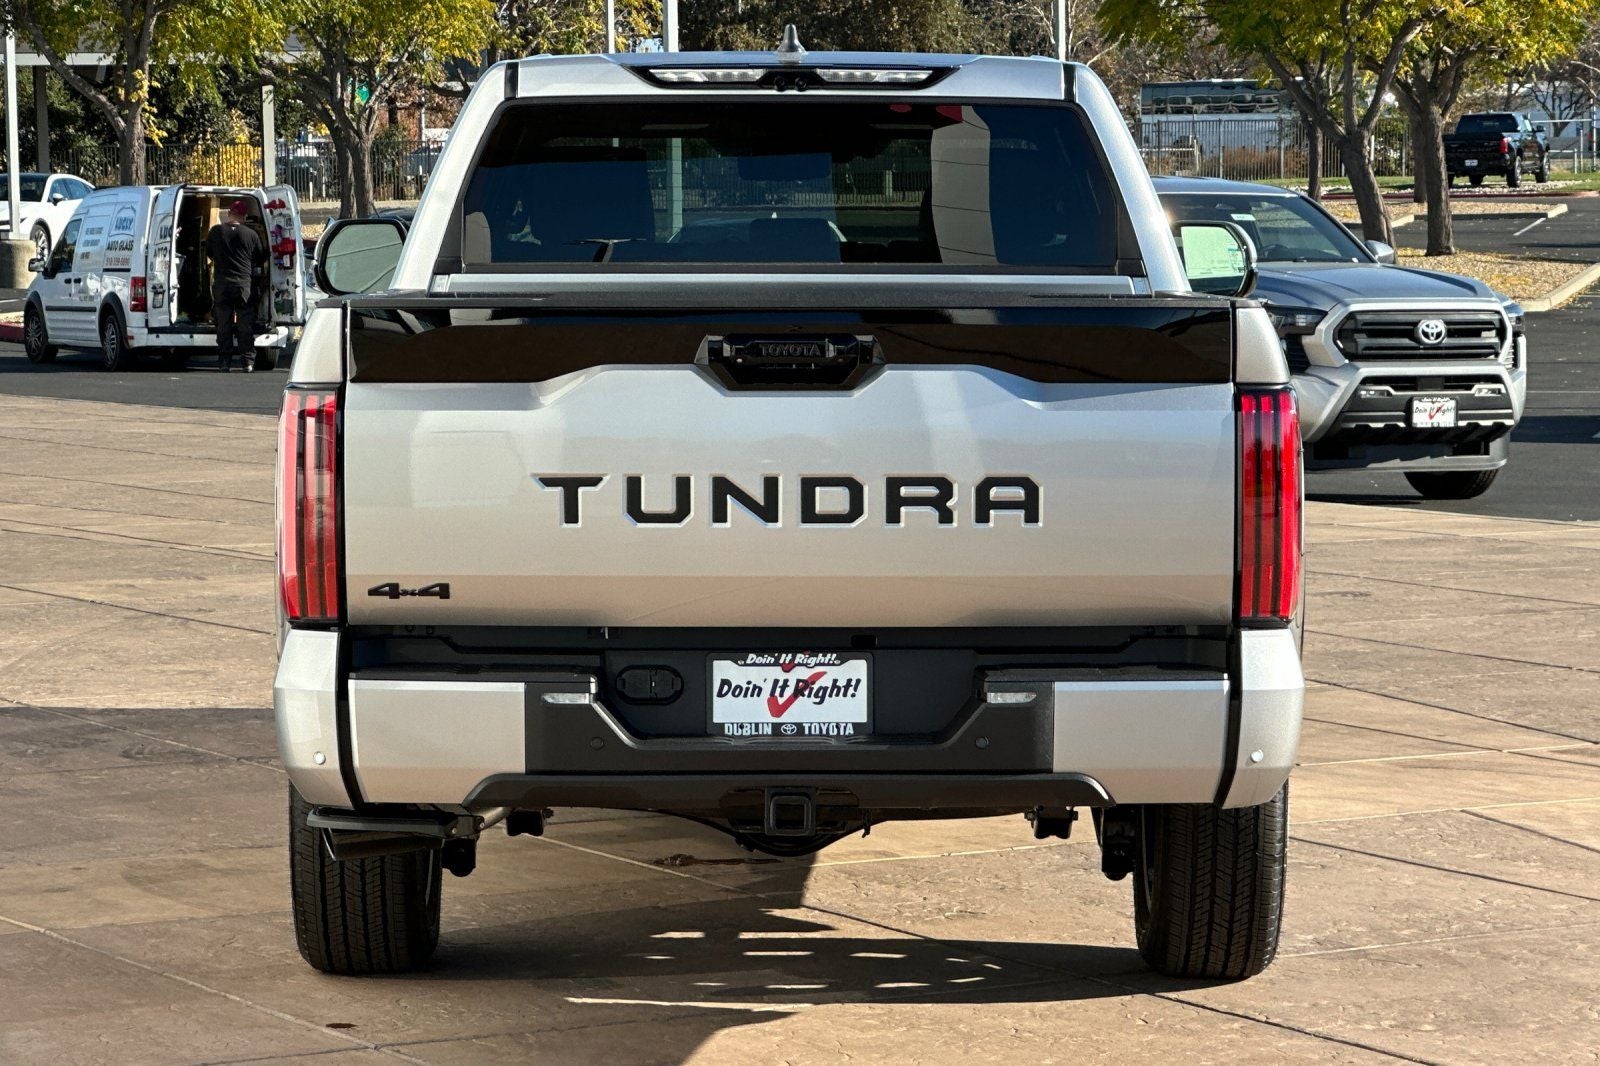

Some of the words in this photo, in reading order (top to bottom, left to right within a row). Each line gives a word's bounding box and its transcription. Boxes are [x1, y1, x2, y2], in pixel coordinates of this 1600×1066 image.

[759, 343, 821, 358] TOYOTA
[531, 473, 1043, 527] TUNDRA
[367, 582, 450, 600] 4x4
[745, 653, 779, 665] Doin'
[779, 653, 794, 664] It
[794, 653, 837, 668] Right!
[716, 678, 768, 699] Doin'
[769, 678, 790, 698] It
[793, 678, 862, 705] Right!
[724, 723, 772, 735] DUBLIN
[802, 723, 854, 735] TOYOTA
